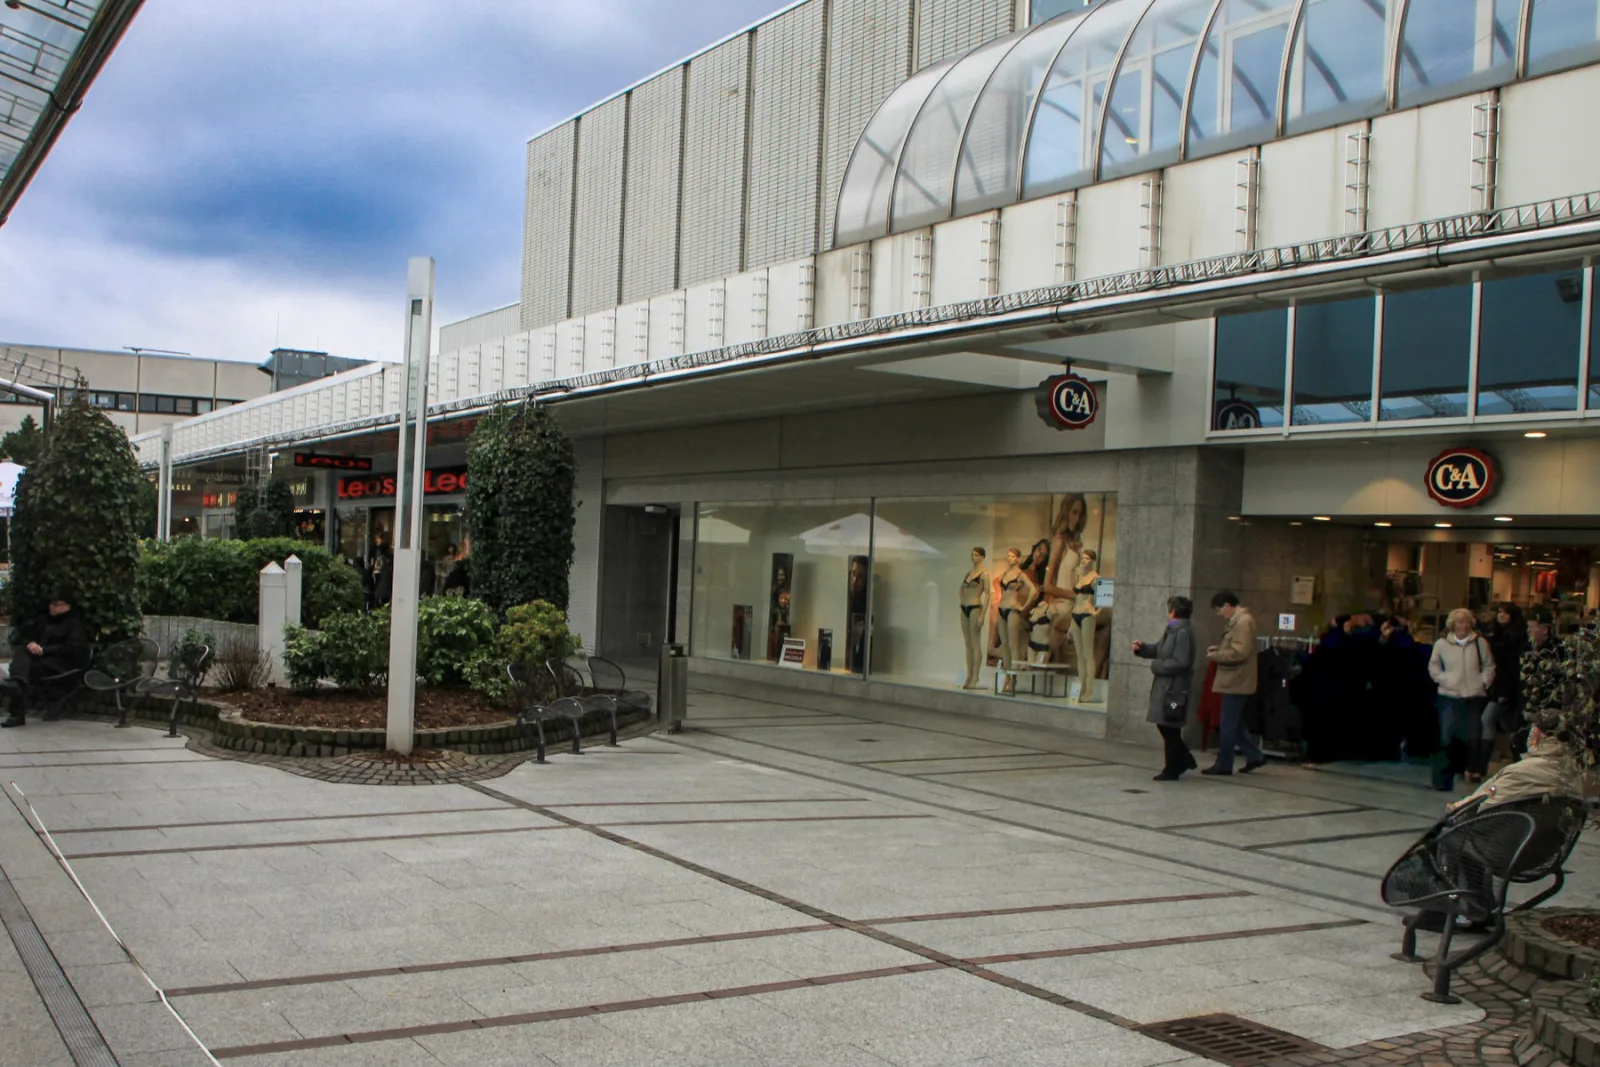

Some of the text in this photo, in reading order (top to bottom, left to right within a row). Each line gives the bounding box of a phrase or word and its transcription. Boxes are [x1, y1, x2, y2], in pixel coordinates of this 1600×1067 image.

[1060, 387, 1091, 415] C&A
[337, 475, 397, 498] Leo's
[1435, 463, 1480, 490] C&A
